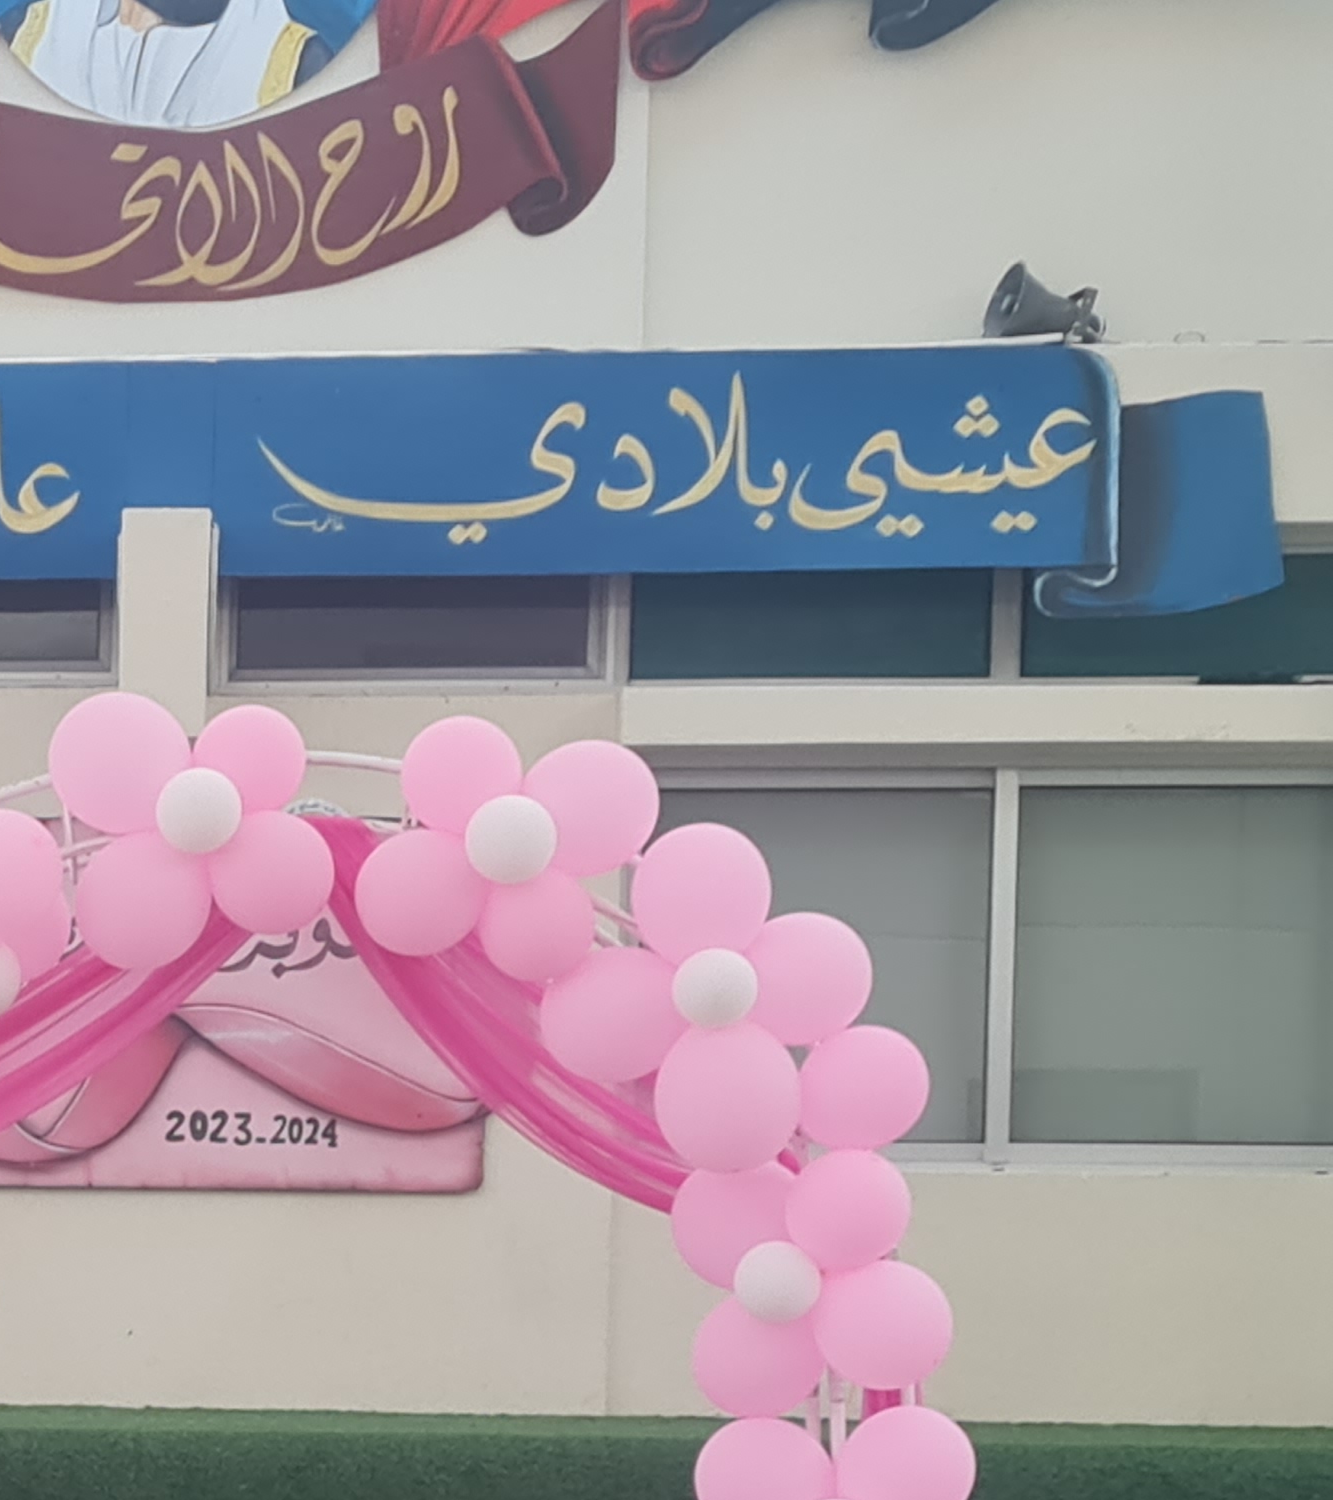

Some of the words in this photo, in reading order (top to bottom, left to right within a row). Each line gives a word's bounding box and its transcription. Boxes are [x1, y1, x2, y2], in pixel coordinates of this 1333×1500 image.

[310, 84, 461, 268] روح
[255, 369, 787, 545] بلادي
[786, 396, 1099, 538] عيشي
